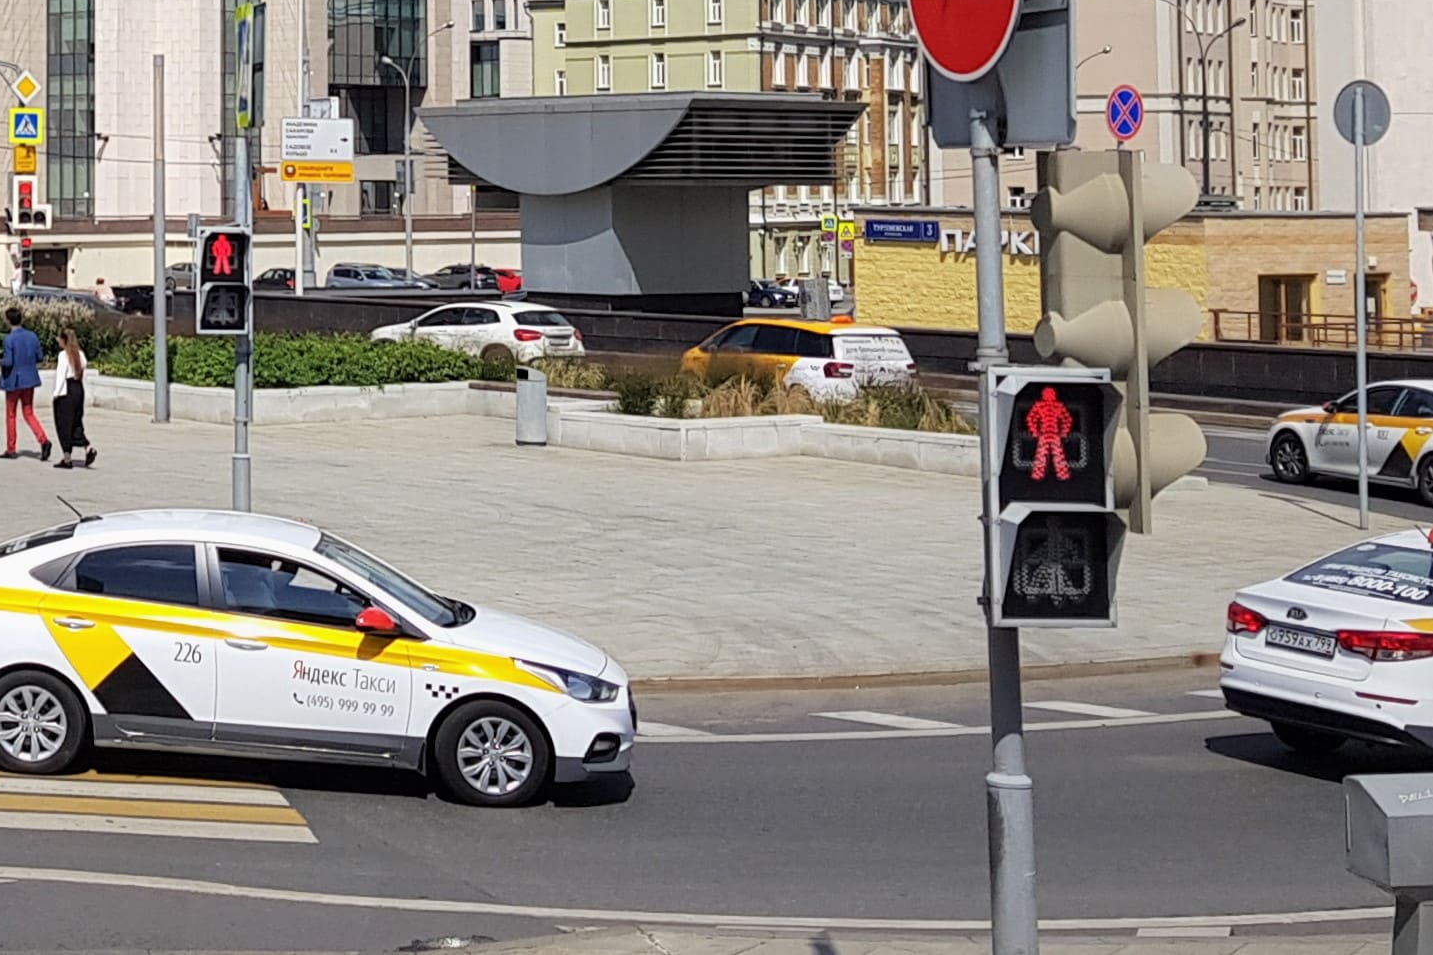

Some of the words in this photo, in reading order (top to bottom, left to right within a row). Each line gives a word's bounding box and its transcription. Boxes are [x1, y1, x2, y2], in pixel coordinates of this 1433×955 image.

[926, 224, 933, 236] 3
[1347, 575, 1430, 601] 6000-100
[174, 641, 202, 664] 226
[292, 659, 347, 688] Яндекс
[352, 667, 397, 695] Такси
[306, 693, 334, 711] (495)
[338, 697, 359, 713] 999
[362, 700, 377, 715] 99
[380, 703, 395, 717] 99
